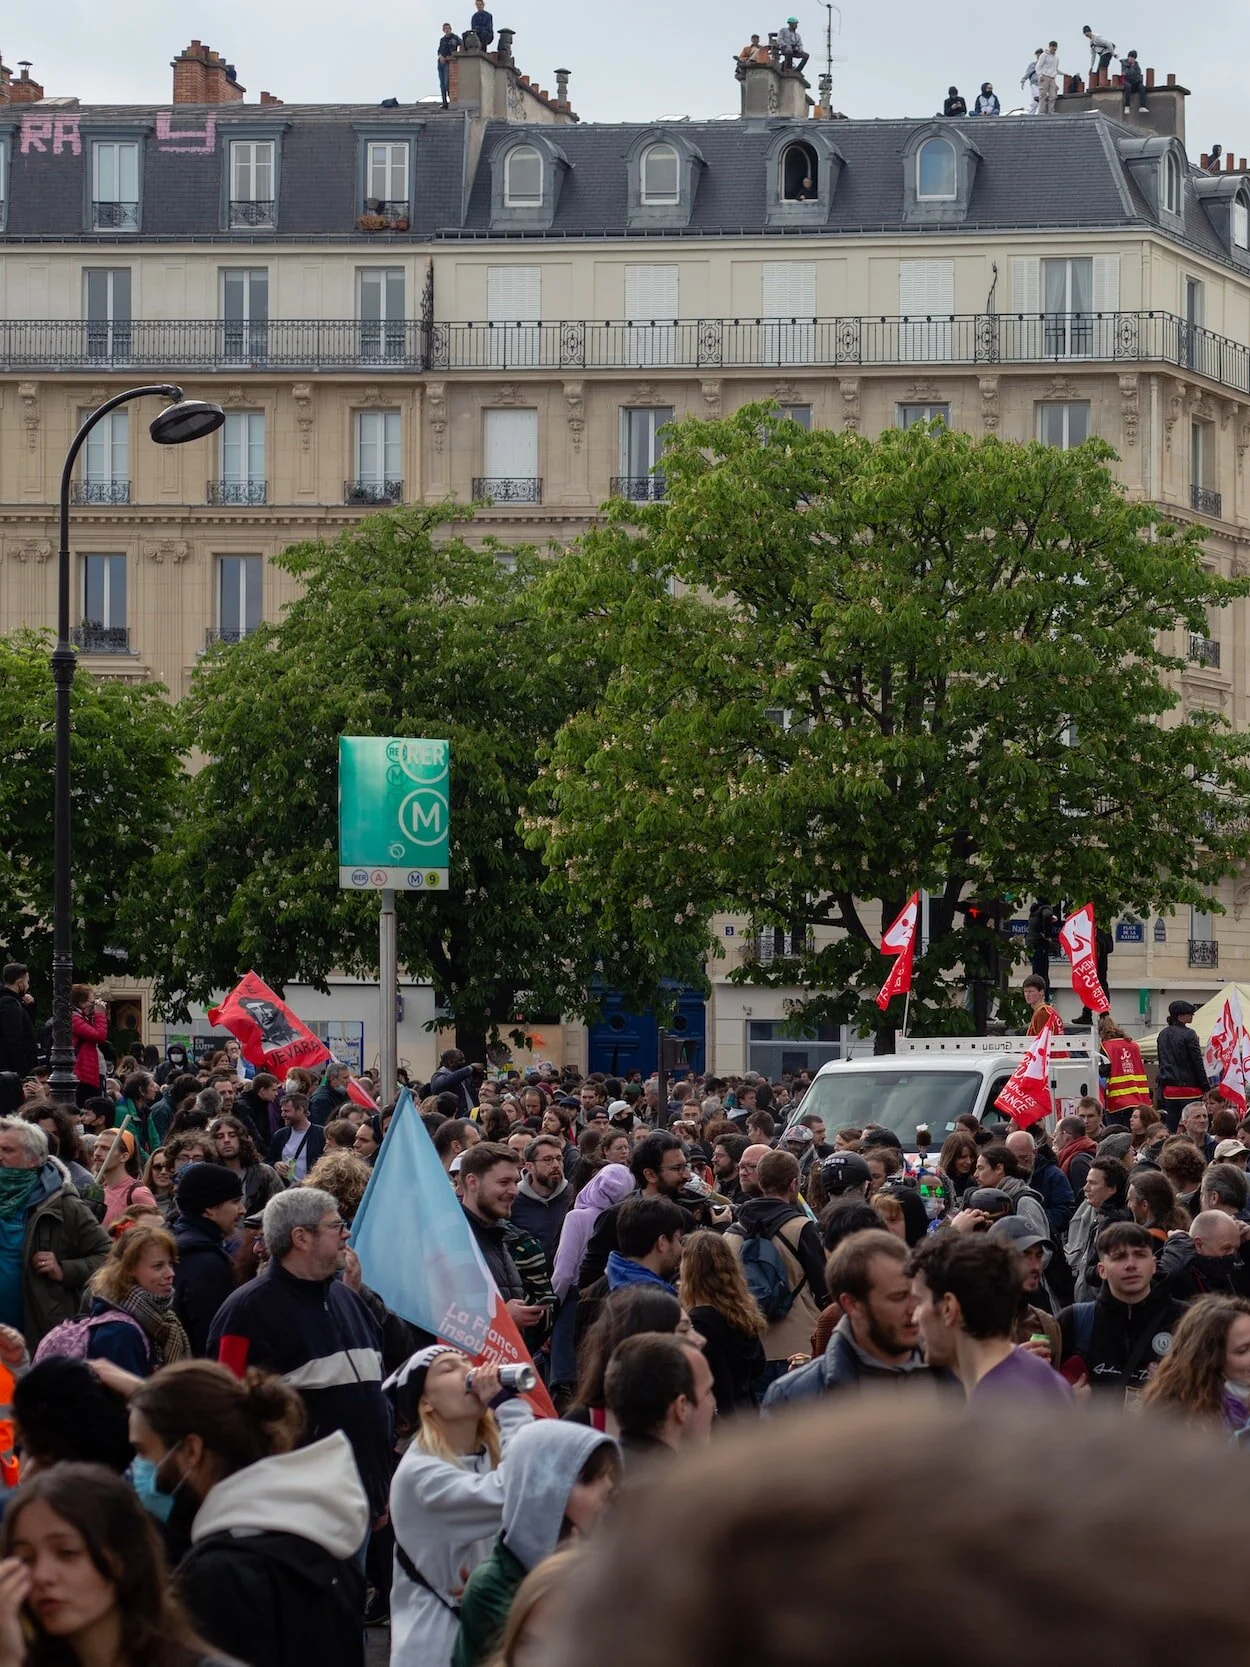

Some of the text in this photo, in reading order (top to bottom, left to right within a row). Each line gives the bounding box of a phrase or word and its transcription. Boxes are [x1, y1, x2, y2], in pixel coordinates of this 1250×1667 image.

[406, 741, 446, 766] RER
[412, 800, 440, 833] M
[353, 873, 366, 881] RER
[410, 874, 420, 883] M
[429, 874, 436, 885] 9
[437, 1317, 510, 1365] insoumis
[446, 1302, 519, 1359] La France
